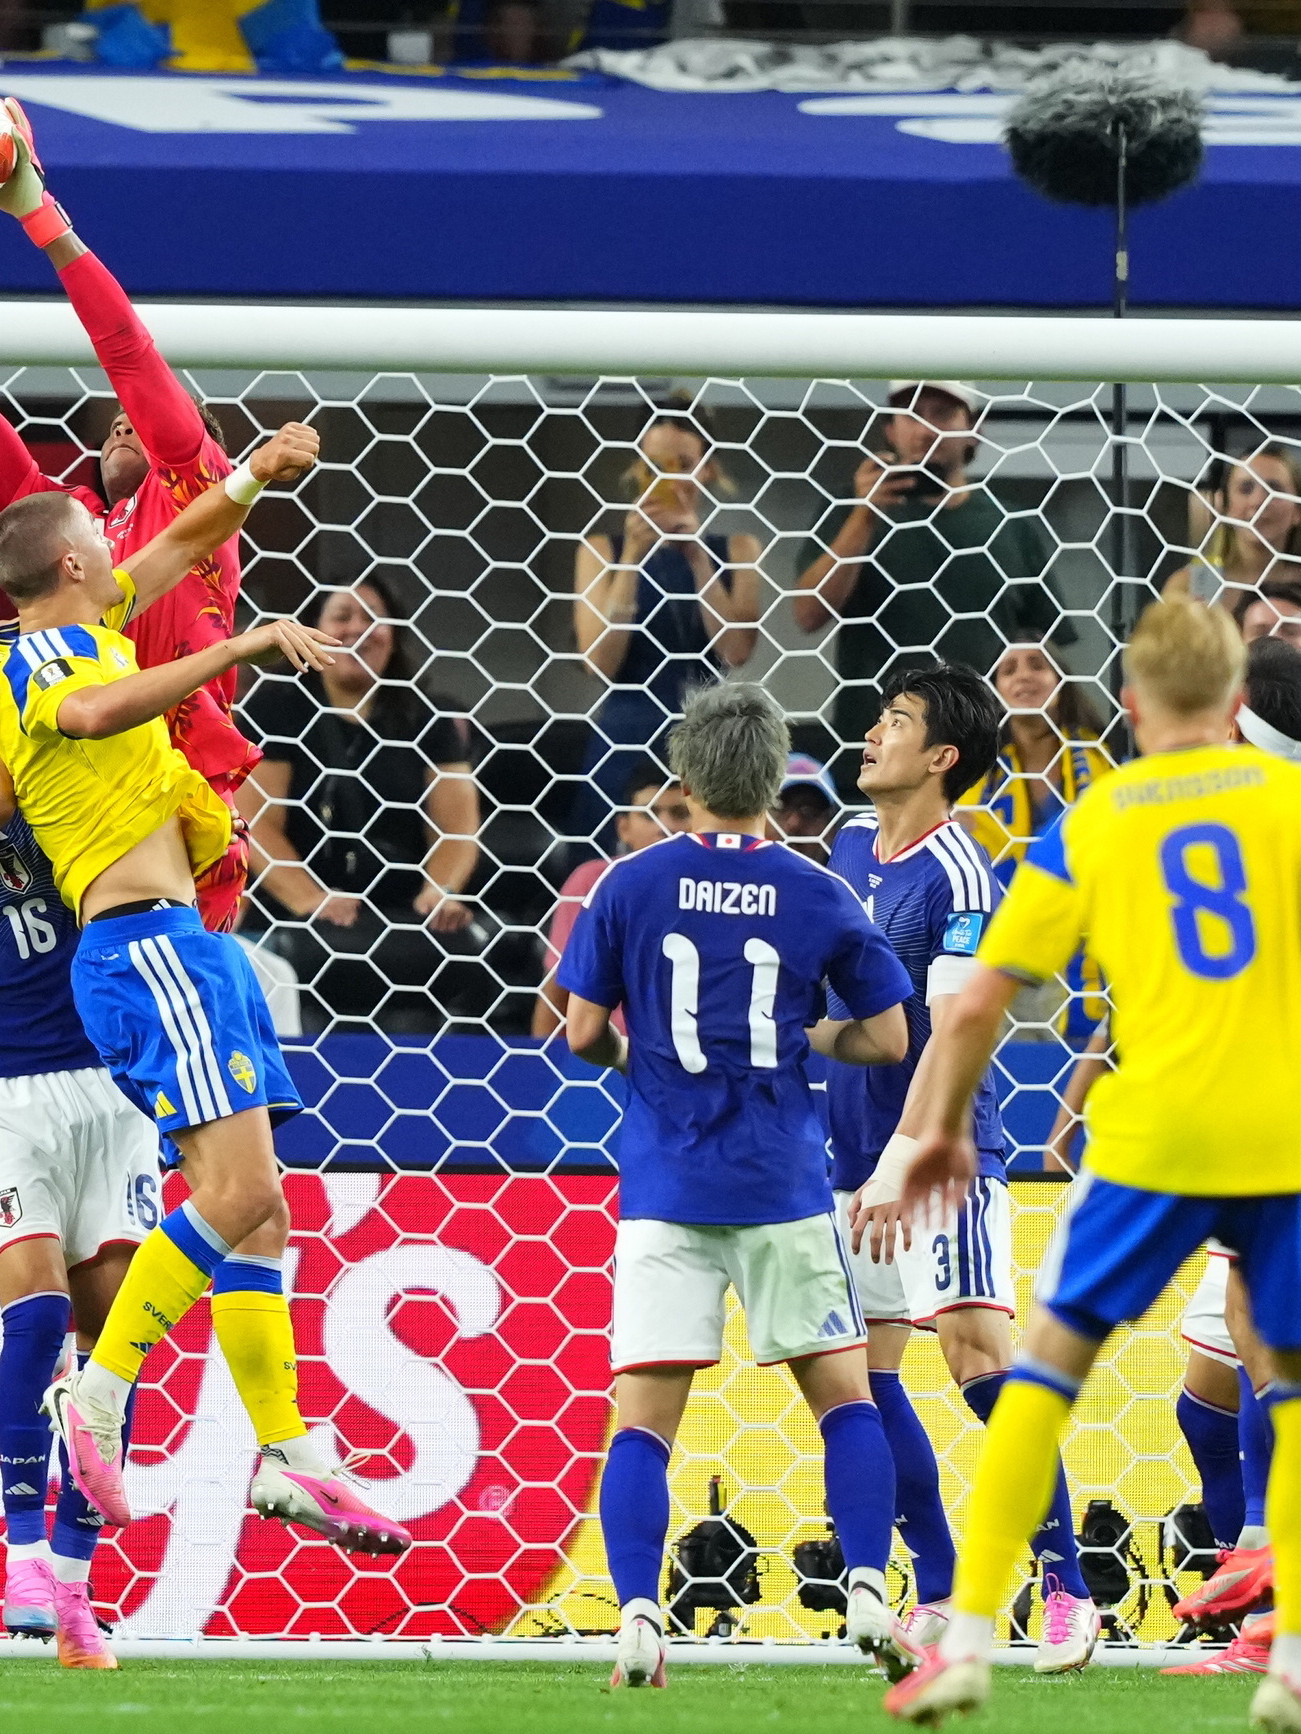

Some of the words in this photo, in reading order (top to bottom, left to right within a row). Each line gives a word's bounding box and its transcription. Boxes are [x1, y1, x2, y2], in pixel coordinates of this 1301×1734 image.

[678, 877, 777, 917] DAIZEN
[1160, 822, 1257, 981] 8
[2, 897, 57, 960] 16
[662, 932, 781, 1074] 11
[932, 1233, 951, 1291] 3
[143, 1301, 175, 1332] SVER
[0, 1454, 46, 1465] JAPAN
